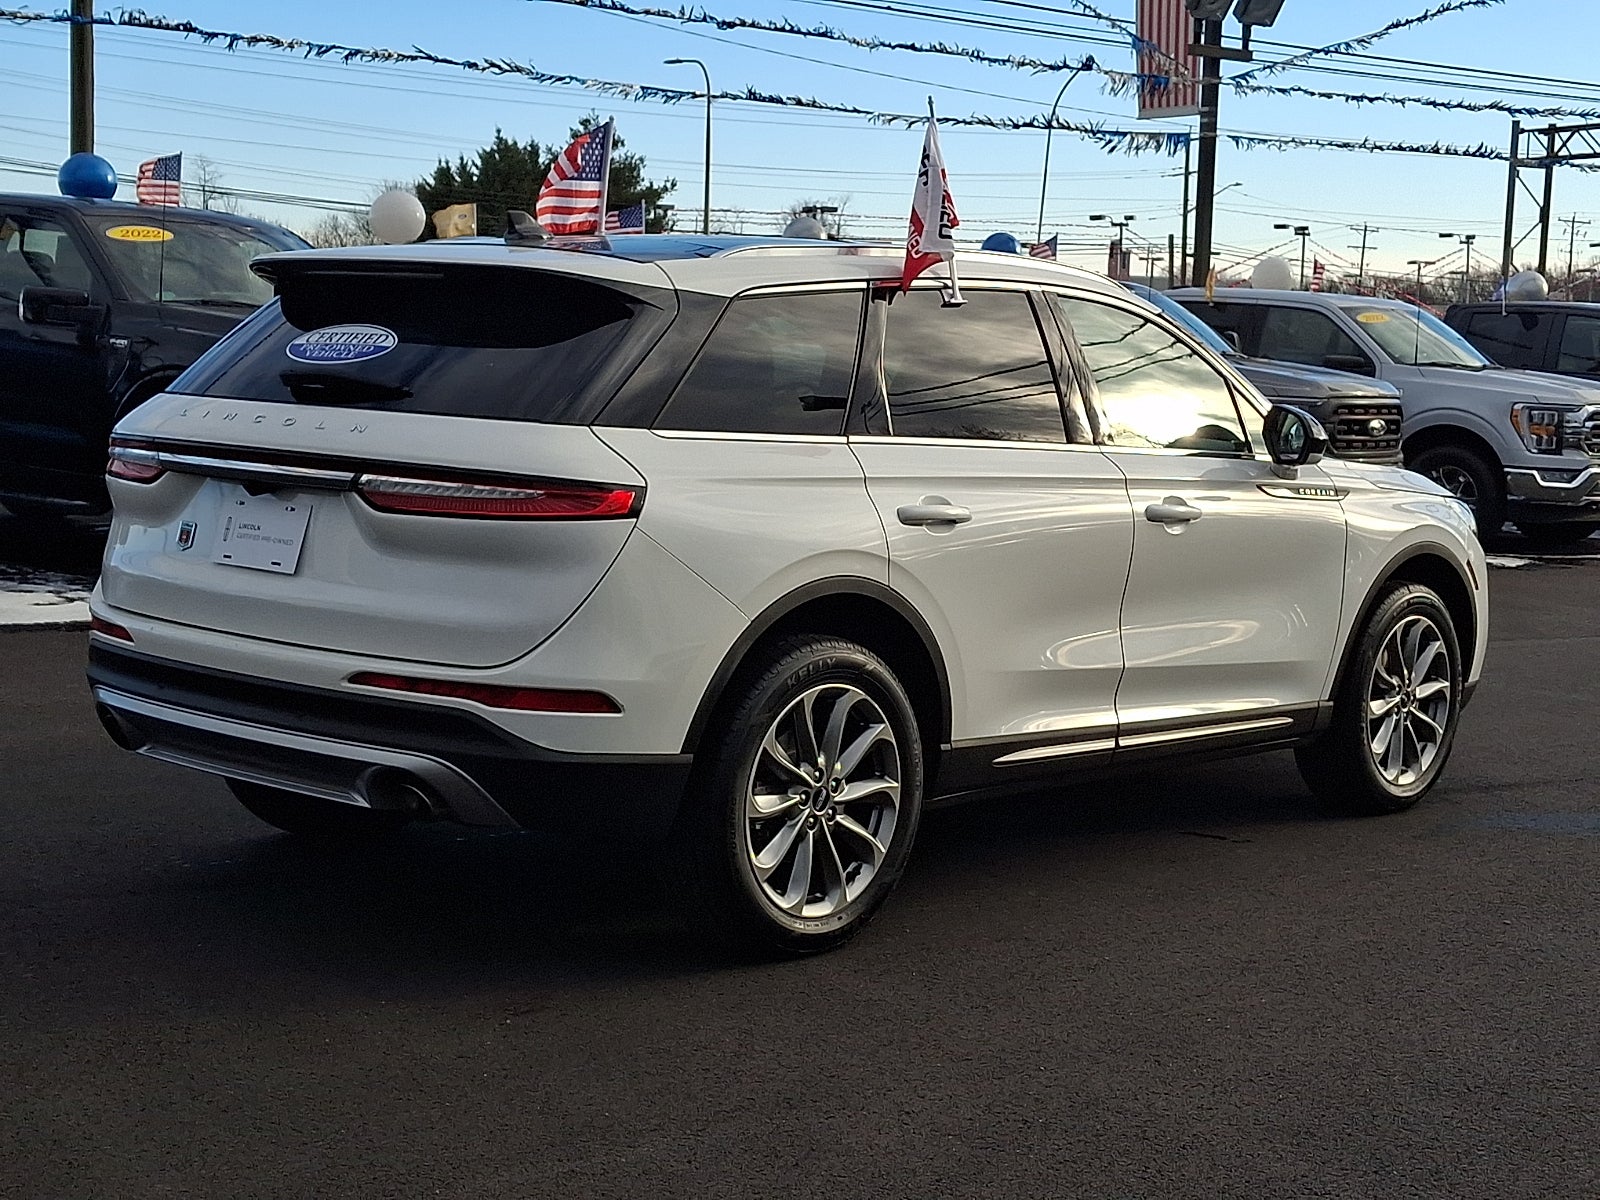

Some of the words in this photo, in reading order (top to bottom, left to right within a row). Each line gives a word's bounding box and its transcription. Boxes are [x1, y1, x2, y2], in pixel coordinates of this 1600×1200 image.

[120, 229, 161, 238] 2022
[306, 332, 389, 344] CERTIFIED
[300, 344, 375, 352] PRE-OWNED
[306, 350, 357, 358] VEHICLE
[180, 409, 369, 433] LINCOLN
[238, 523, 261, 531] LINCOLN
